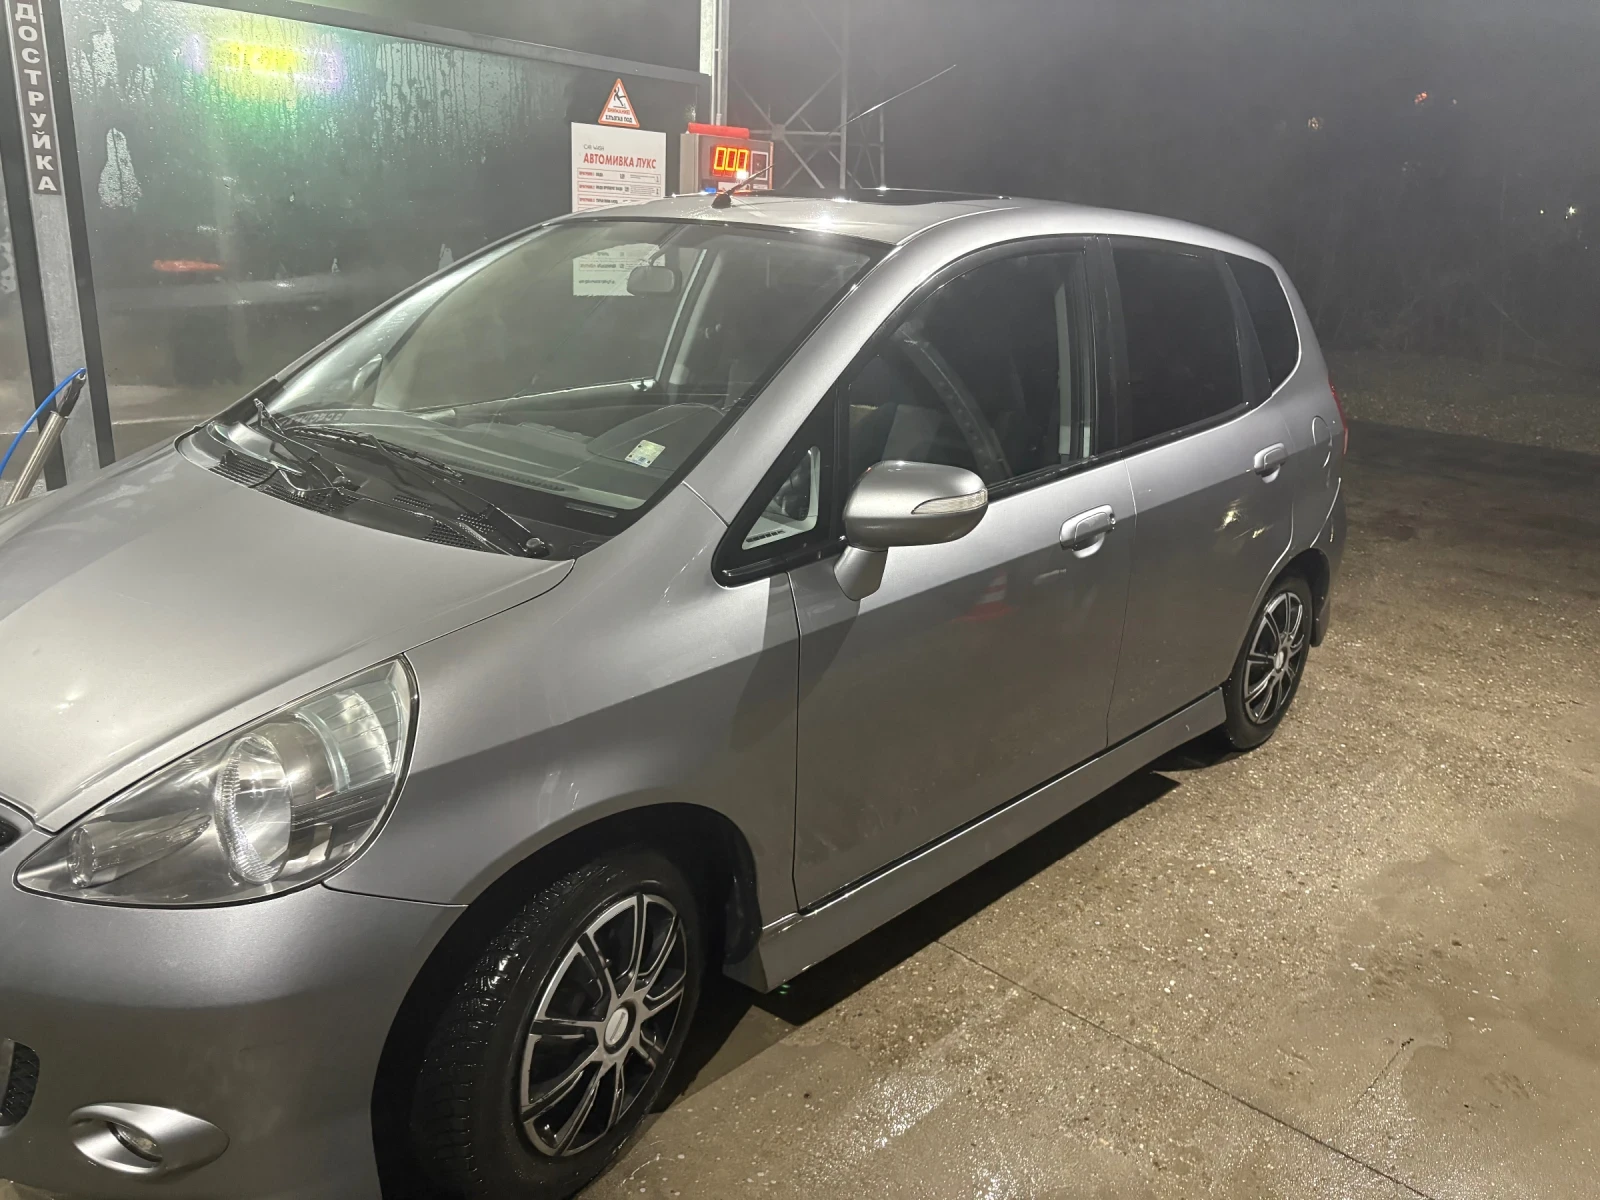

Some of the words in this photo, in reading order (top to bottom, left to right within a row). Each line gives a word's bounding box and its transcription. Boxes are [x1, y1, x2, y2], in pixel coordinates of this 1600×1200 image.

[15, 2, 57, 192] ДОСТРУЙКА
[583, 153, 634, 168] АВТОМИВКА
[635, 157, 657, 169] ЛУКС
